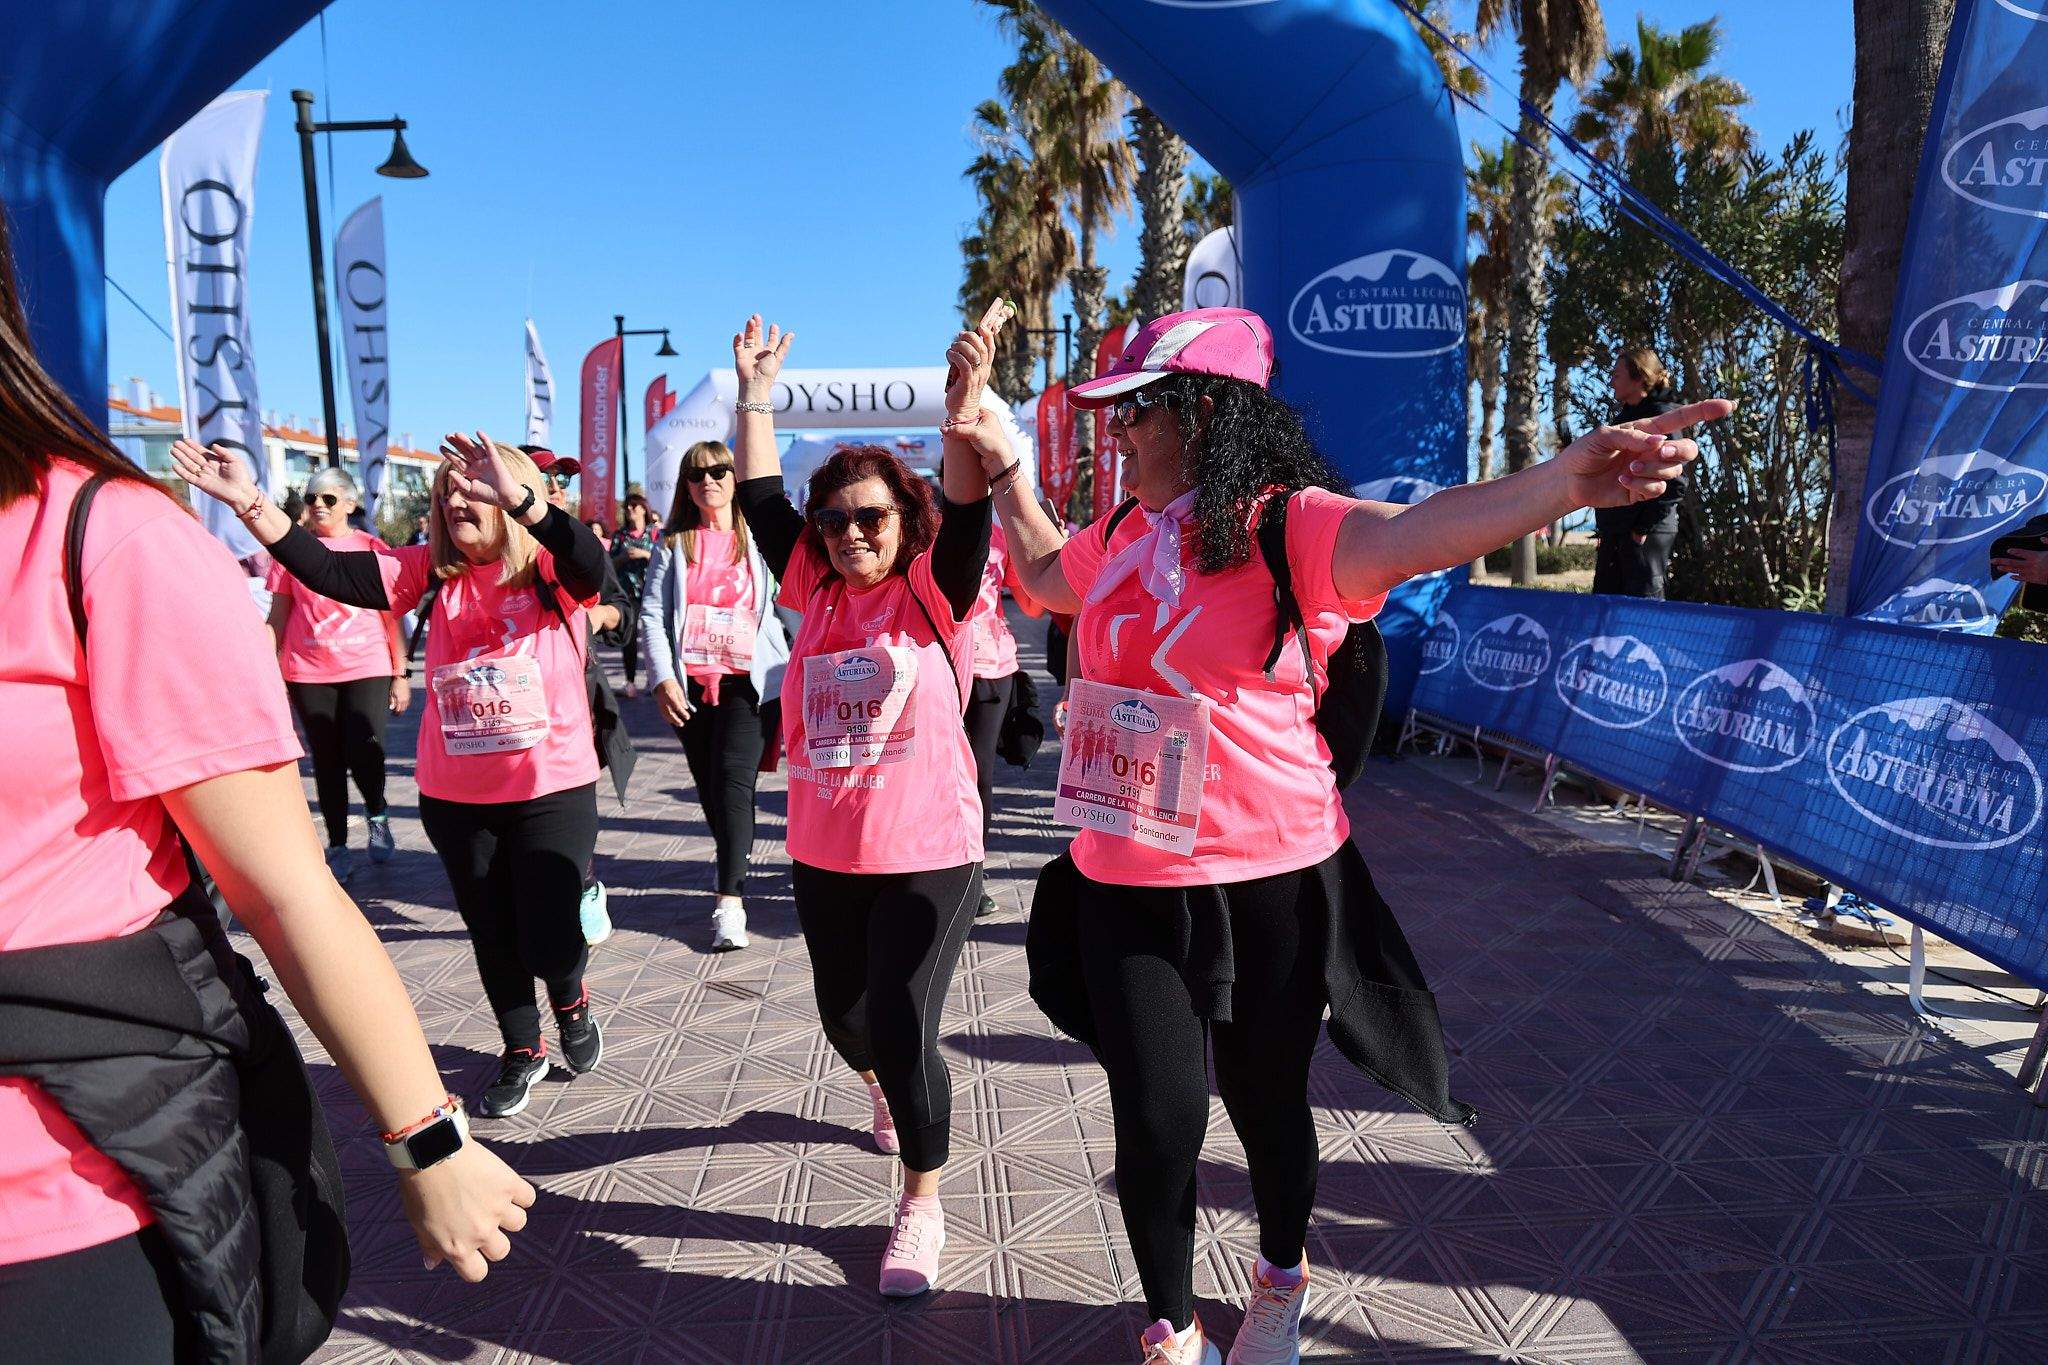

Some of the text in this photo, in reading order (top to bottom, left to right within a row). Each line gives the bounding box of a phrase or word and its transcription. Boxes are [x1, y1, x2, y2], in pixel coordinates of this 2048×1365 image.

[1336, 287, 1408, 300] CENTRAL
[1303, 293, 1463, 335] ASTURIANA
[1967, 318, 2034, 331] CENTRAL
[770, 380, 916, 413] OYSHO
[592, 364, 609, 455] Santander
[669, 419, 716, 428] OYSHO
[709, 633, 735, 645] 016
[836, 667, 877, 678] ASTURIANA
[1558, 655, 1657, 714] ASTURIANA
[472, 700, 512, 718] 016
[837, 699, 883, 721] 016
[846, 724, 868, 734] 9190
[1679, 689, 1796, 757] ASTURIANA
[838, 737, 847, 745] DE
[815, 750, 848, 762] OYSHO
[871, 746, 908, 757] Santander
[1111, 753, 1156, 785] 016
[817, 769, 829, 786] DE
[830, 773, 841, 788] LA
[843, 773, 885, 789] MUJER
[1834, 728, 2015, 834] ASTURIANA
[816, 786, 833, 800] 2025
[1076, 790, 1106, 803] CARRERA
[1107, 796, 1117, 805] DE
[1117, 798, 1127, 808] LA
[1071, 805, 1117, 826] OYSHO
[1139, 824, 1181, 844] Santander
